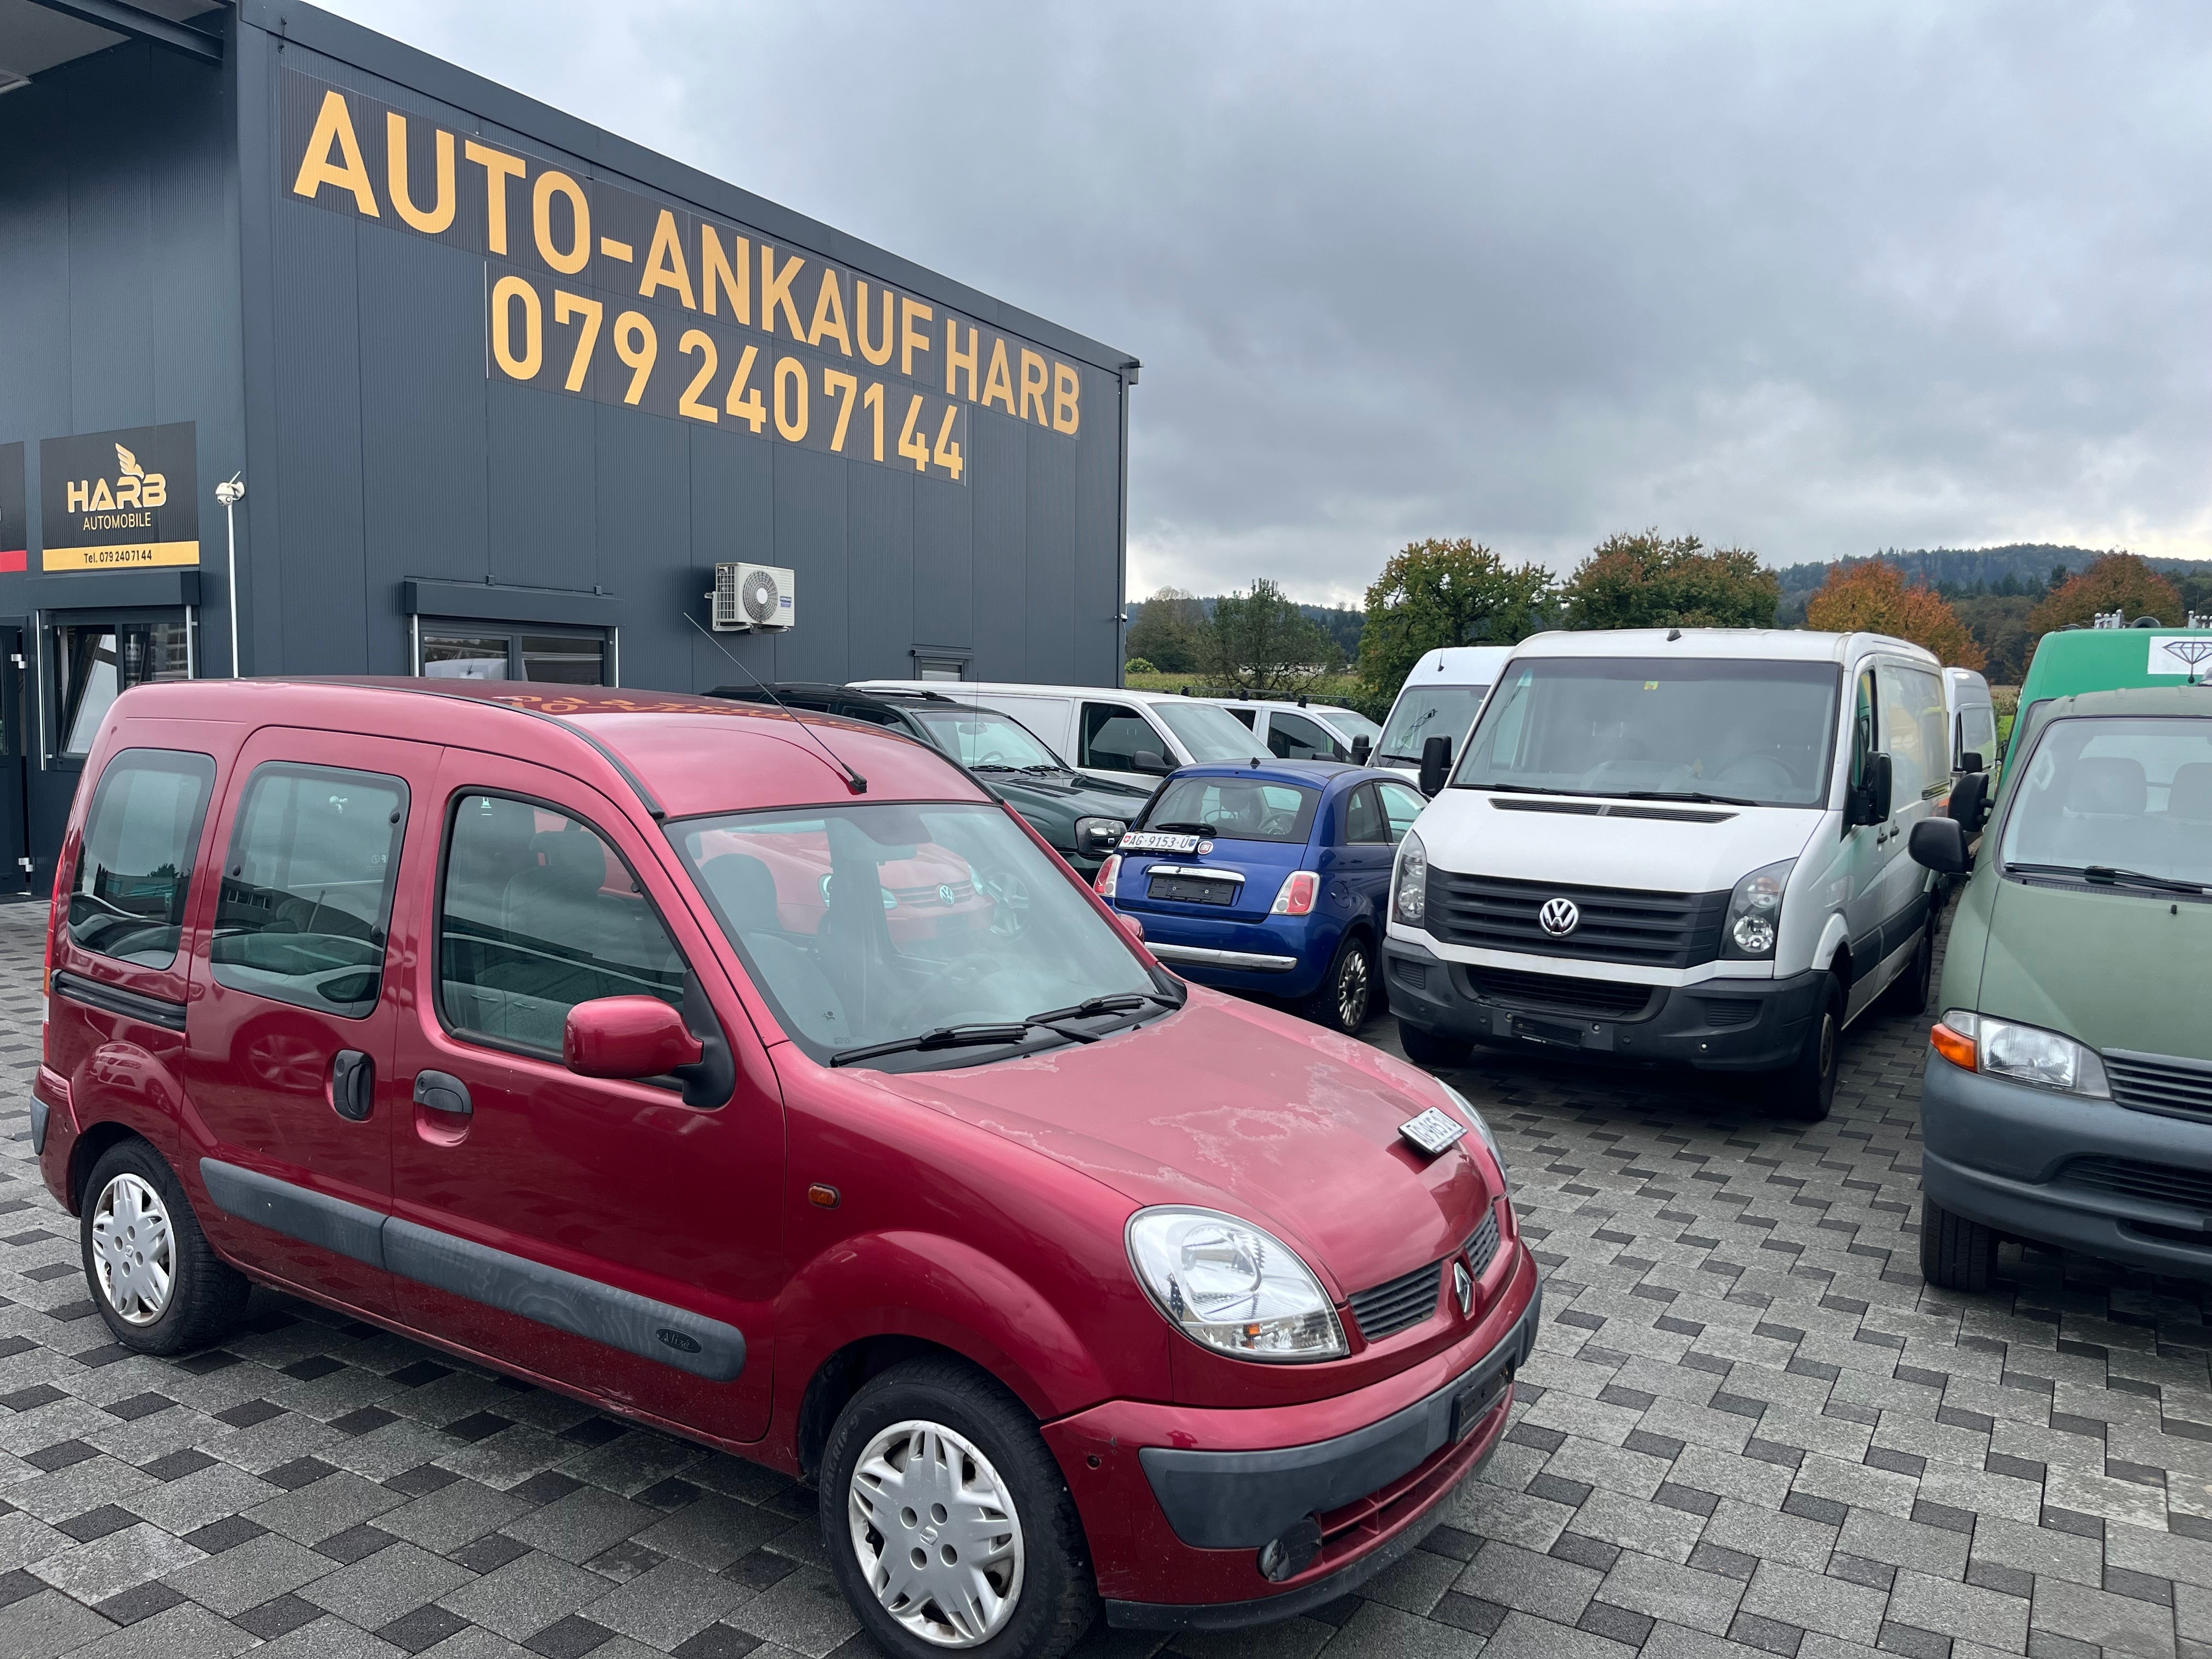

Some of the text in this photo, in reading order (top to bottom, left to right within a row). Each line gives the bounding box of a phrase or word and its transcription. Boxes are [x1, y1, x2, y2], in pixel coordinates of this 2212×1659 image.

[294, 90, 1080, 435] AUTO-ANKAUF HARB
[492, 275, 657, 405] 079
[679, 329, 808, 442] 240
[67, 473, 167, 513] HARB
[83, 511, 151, 531] AUTOMOBILE
[84, 552, 98, 563] Tel.
[99, 551, 114, 562] 079
[115, 550, 130, 562] 240
